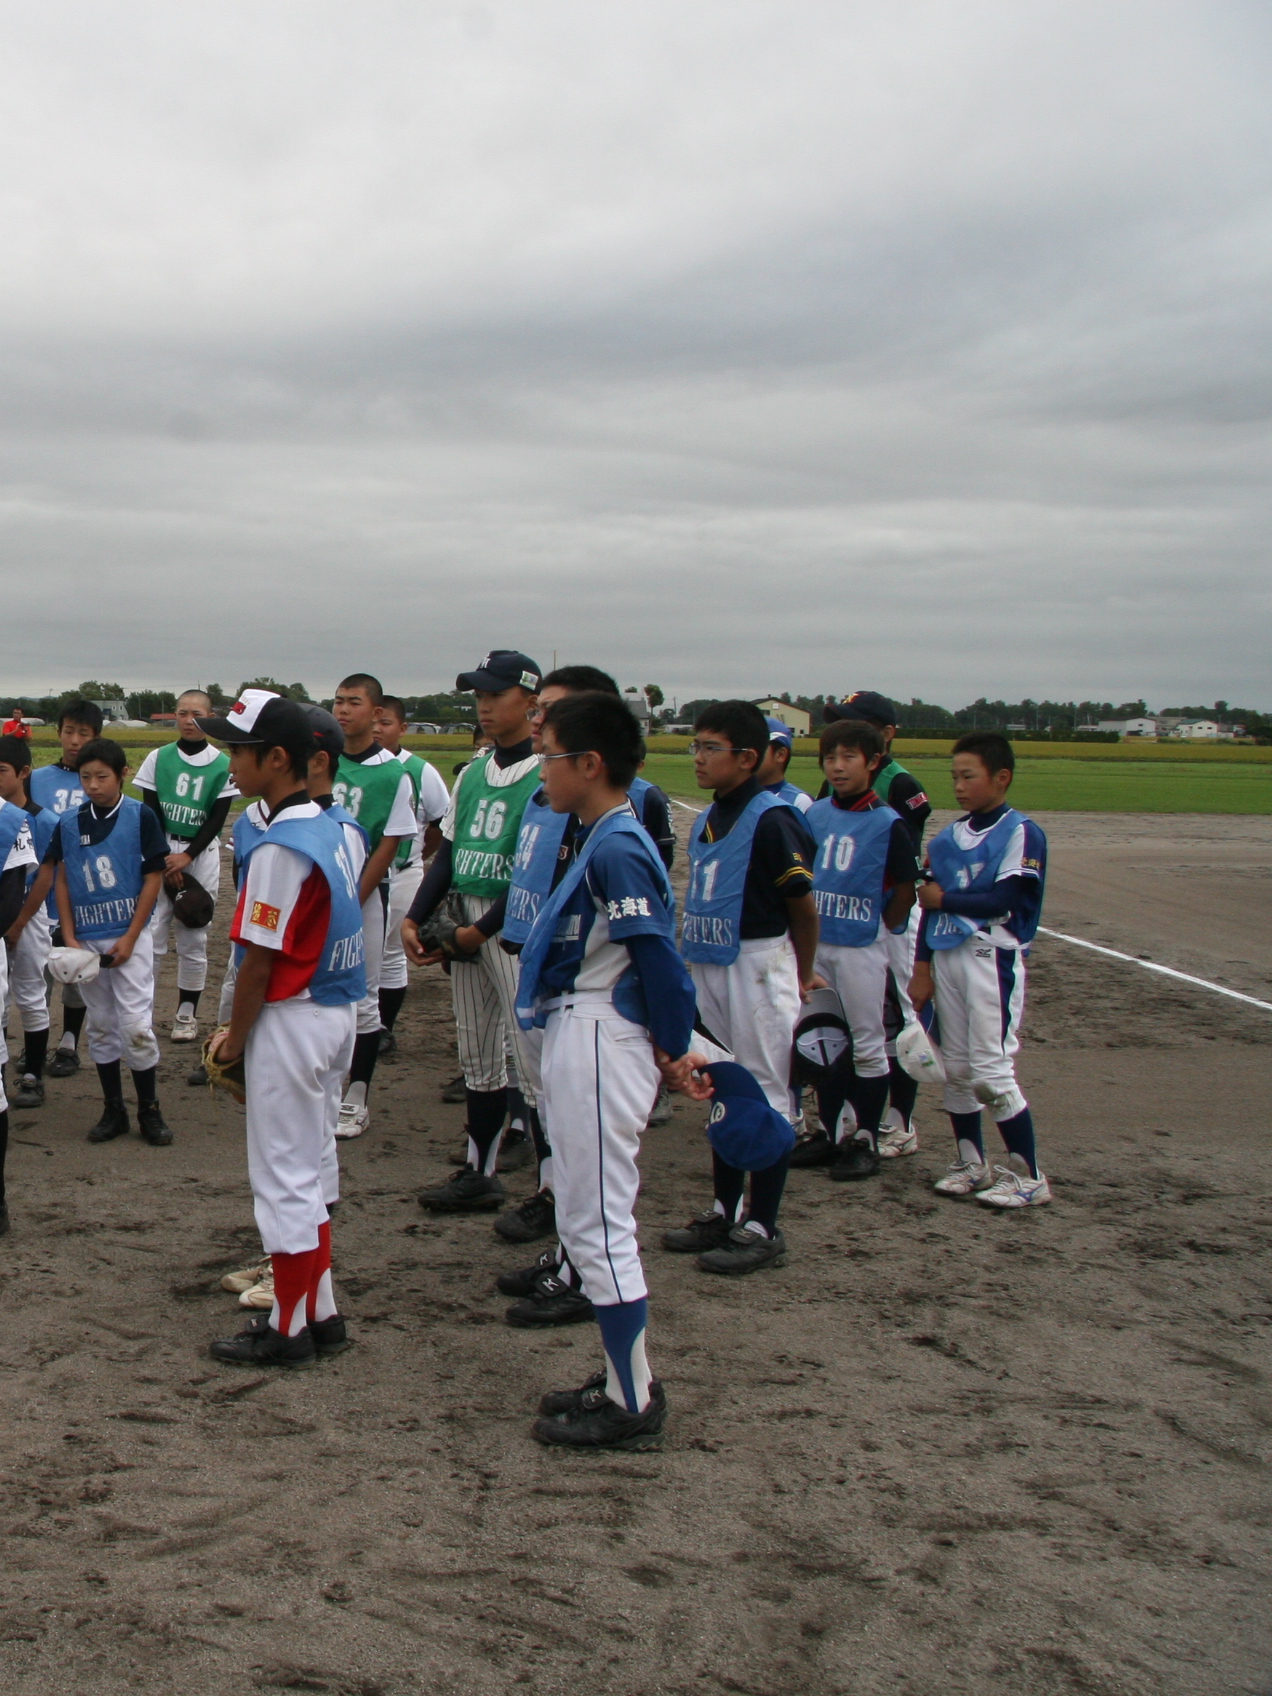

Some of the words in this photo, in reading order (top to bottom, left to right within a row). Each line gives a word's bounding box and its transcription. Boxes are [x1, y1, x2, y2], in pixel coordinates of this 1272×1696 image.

[54, 788, 85, 815] 35
[175, 772, 205, 802] 61
[469, 798, 507, 840] 56
[514, 822, 541, 871] 34
[821, 833, 856, 872] 10
[82, 855, 117, 892] 18
[691, 859, 719, 901] 11
[608, 896, 651, 920] 北海道
